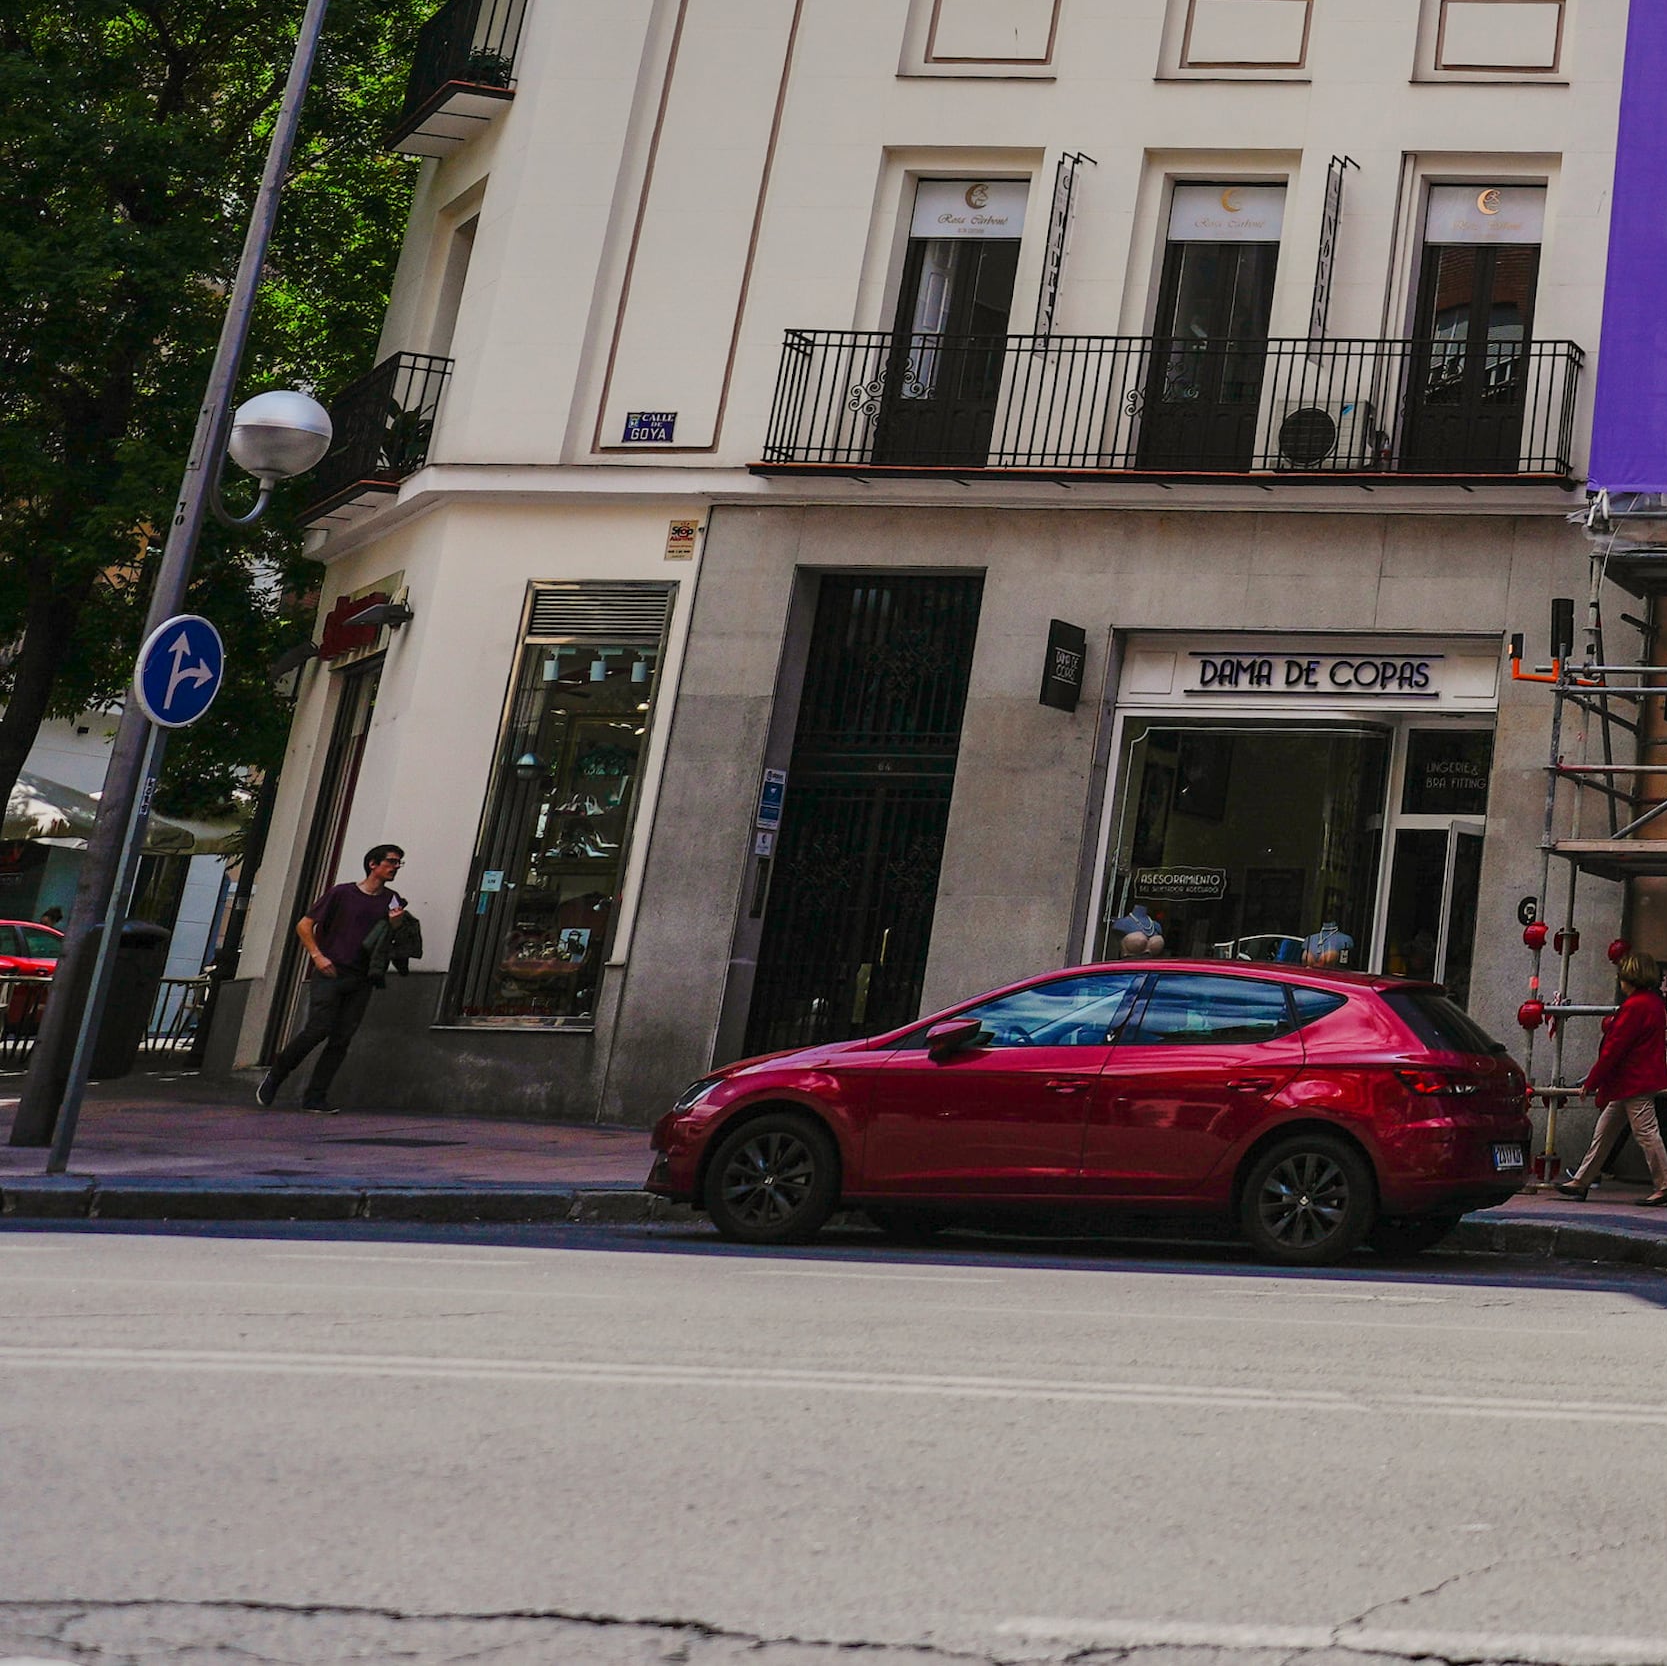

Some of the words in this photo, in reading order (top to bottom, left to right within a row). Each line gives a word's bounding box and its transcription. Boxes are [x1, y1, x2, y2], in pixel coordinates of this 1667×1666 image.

[642, 413, 675, 422] CALLE
[630, 428, 666, 440] GOYA
[1200, 659, 1272, 687] DAMA
[1284, 660, 1320, 687] DE
[1329, 660, 1429, 689] COPAS
[1426, 761, 1470, 774] LINGERIE
[1425, 777, 1447, 789] BRA
[1451, 777, 1487, 790] FITTING
[1140, 874, 1221, 886] ASESORAMIENTO
